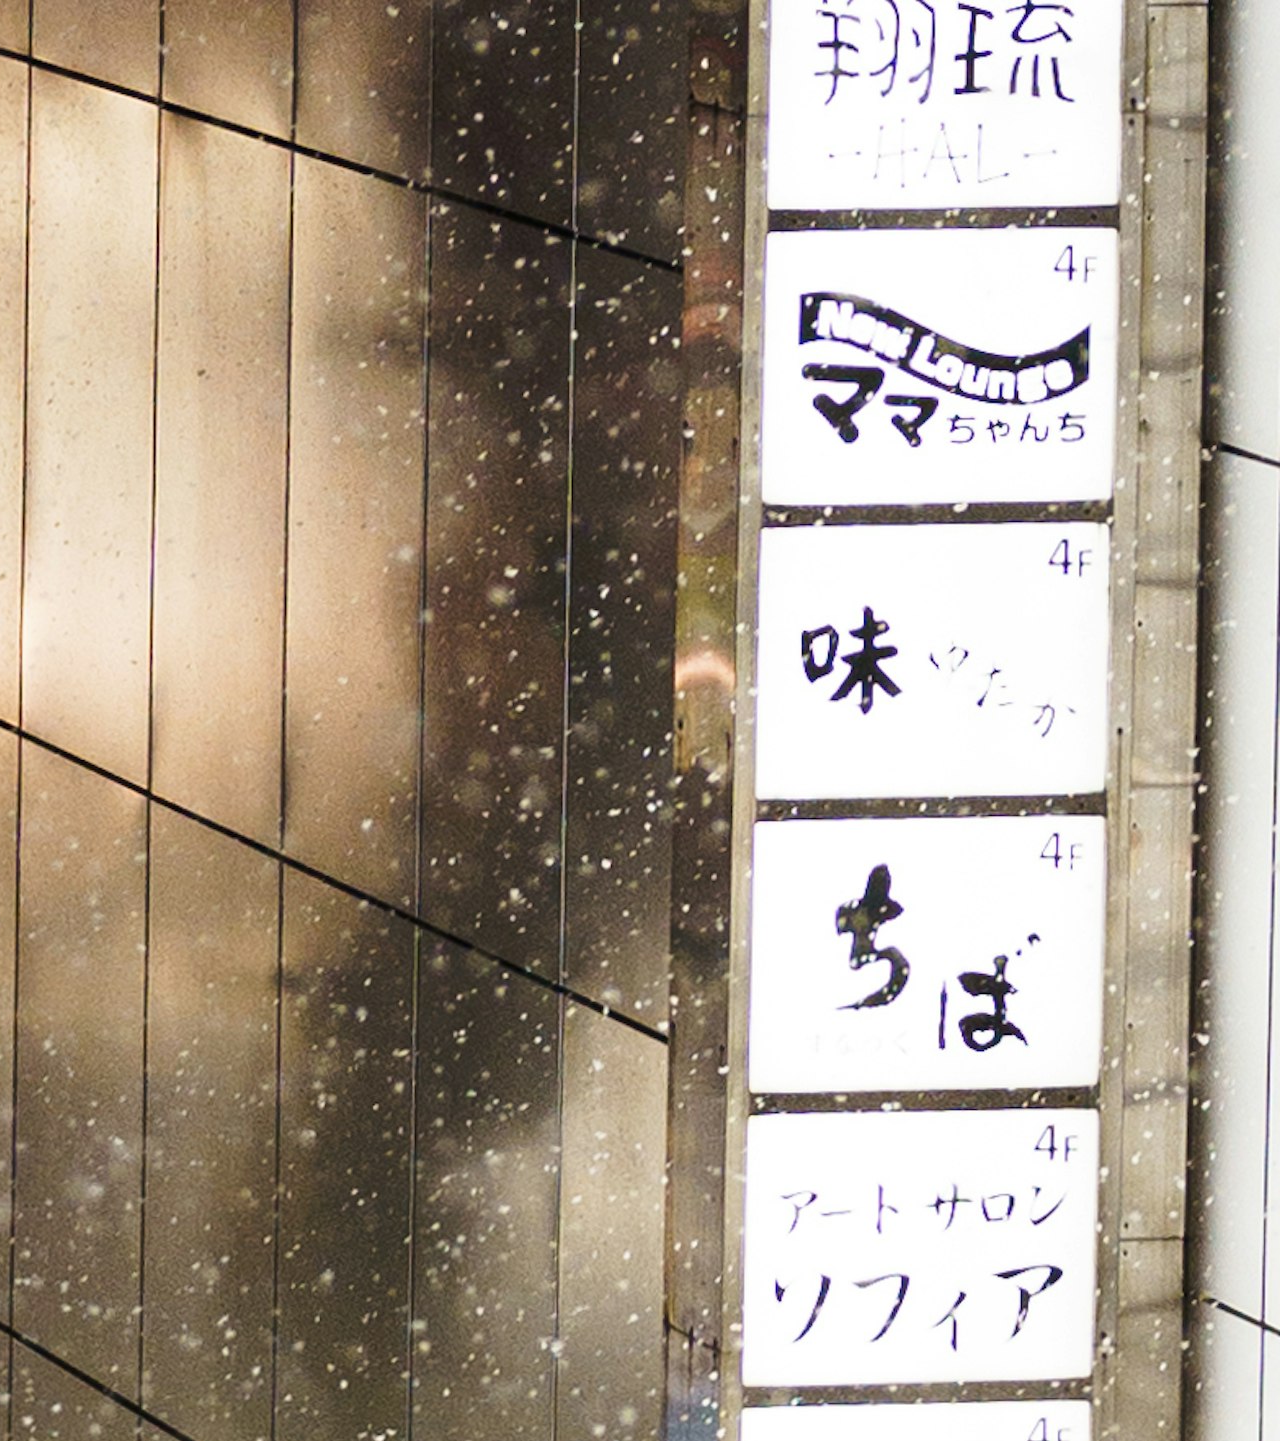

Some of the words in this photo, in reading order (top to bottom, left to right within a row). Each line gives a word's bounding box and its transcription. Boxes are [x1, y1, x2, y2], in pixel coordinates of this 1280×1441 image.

[1054, 245, 1096, 283] 4F
[1048, 539, 1094, 578] 4F
[1040, 832, 1082, 871] 4F
[835, 863, 1040, 1051] ちば
[1034, 1124, 1078, 1163] 4F
[775, 1265, 1063, 1351] ソフィア
